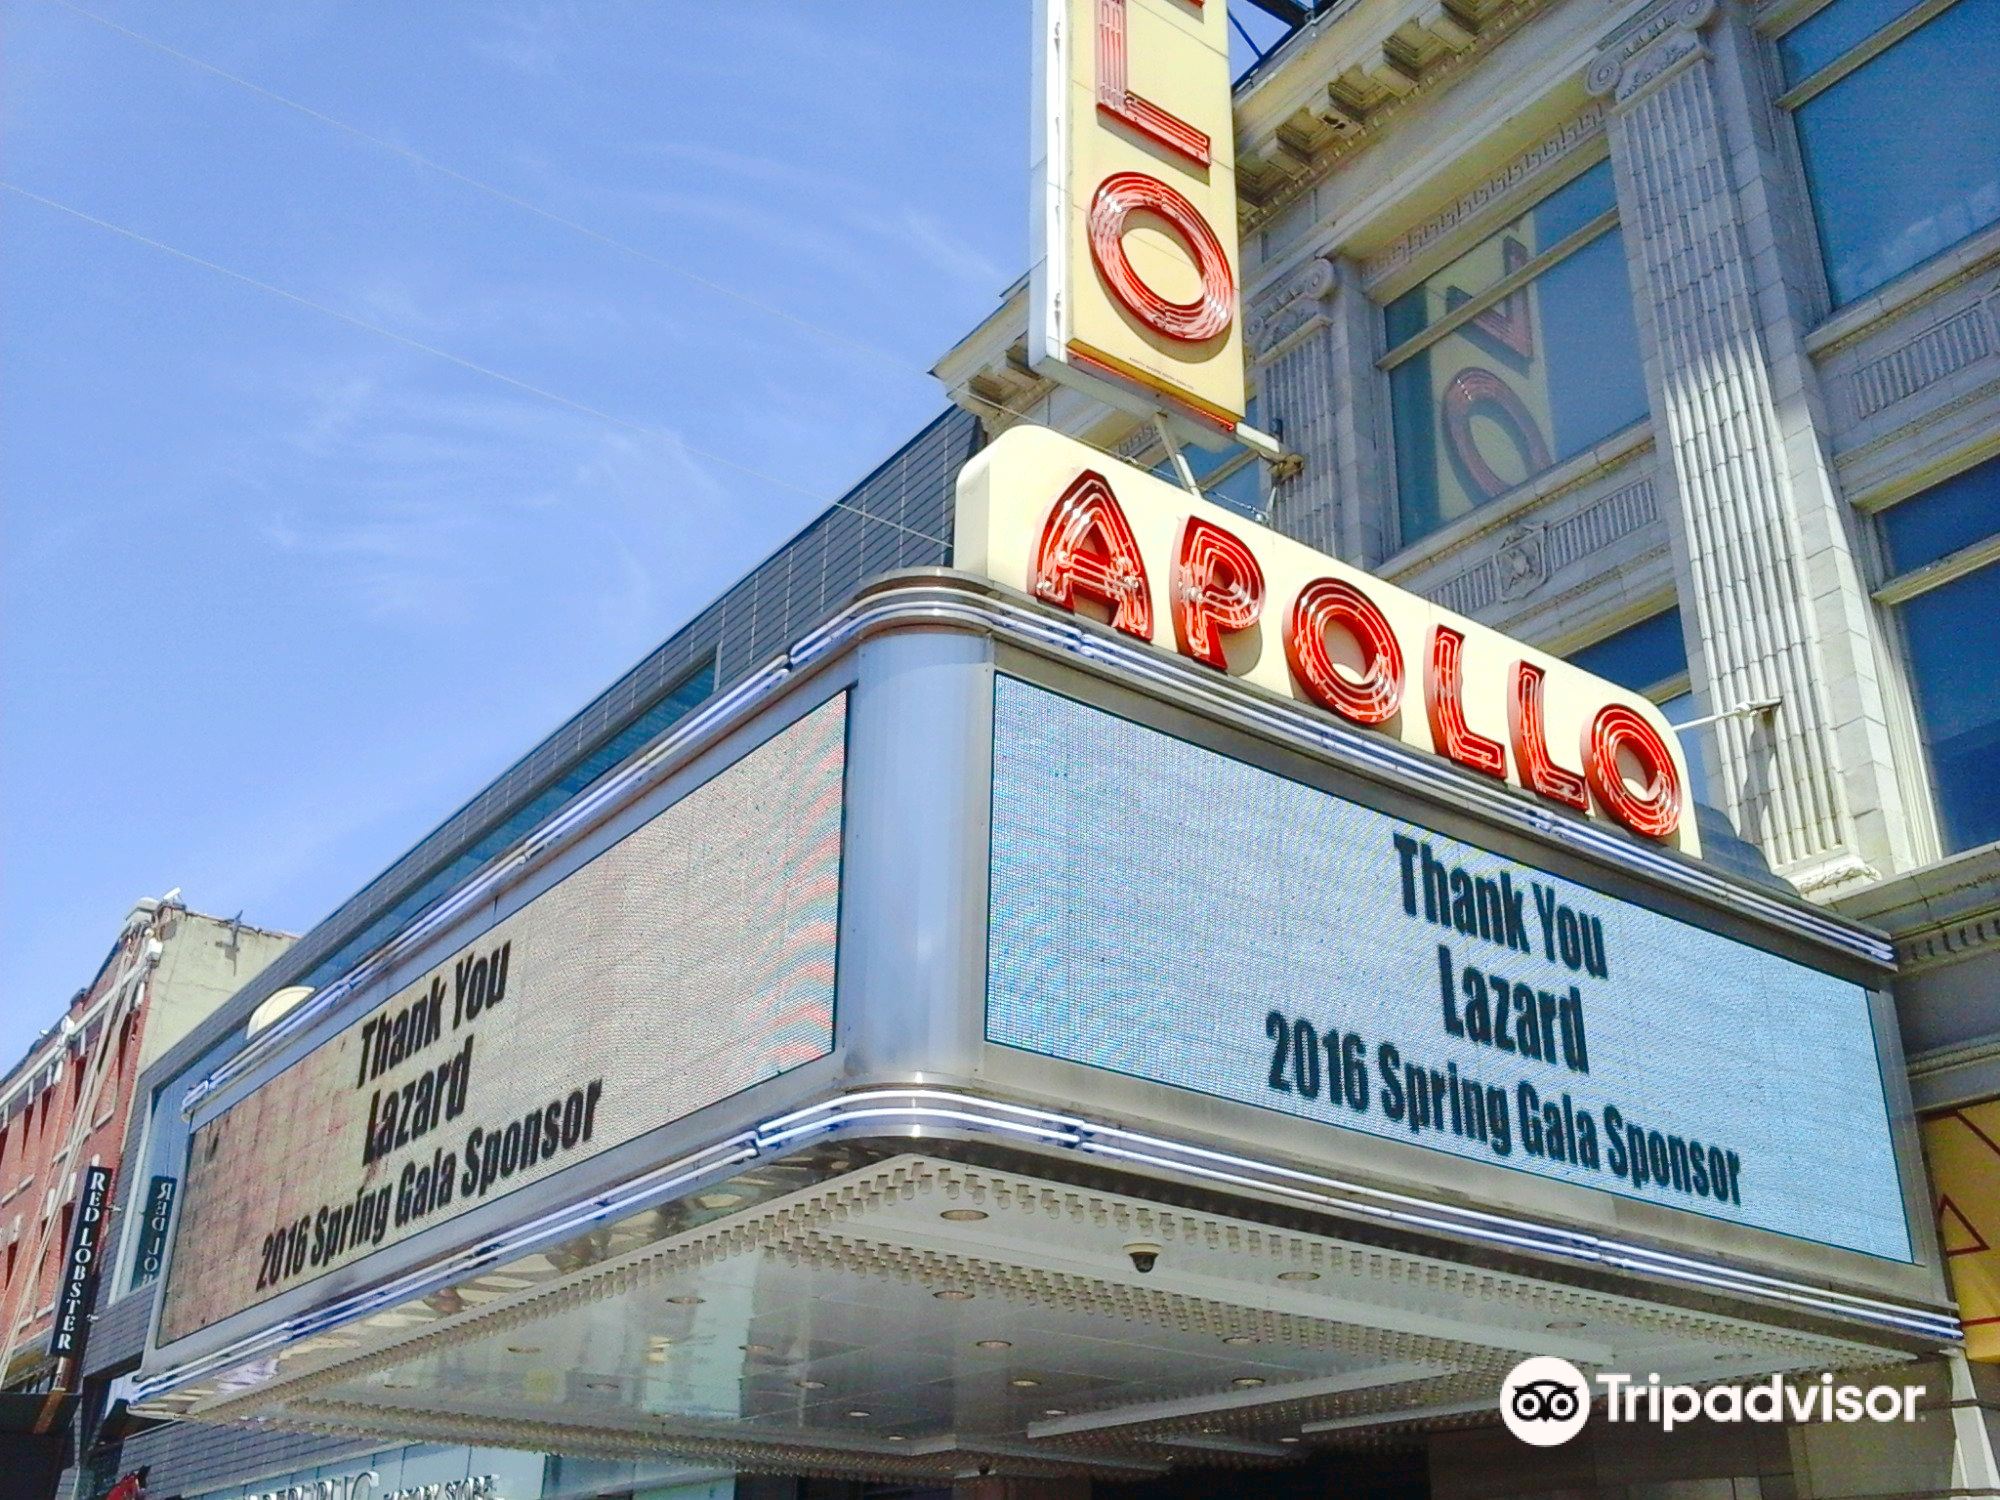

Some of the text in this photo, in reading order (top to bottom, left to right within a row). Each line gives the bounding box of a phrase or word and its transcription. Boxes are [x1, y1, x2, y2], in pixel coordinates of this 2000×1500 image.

[1086, 0, 1234, 342] LO
[1026, 468, 1682, 838] APOLLO
[1393, 833, 1608, 980] Thank You
[356, 940, 512, 1089] Thank You
[1438, 944, 1590, 1074] Lazard
[255, 1078, 602, 1292] 2016 Spring Gala Sponsor
[362, 1034, 474, 1167] Lazard
[1264, 1010, 1742, 1206] 2016 Spring Gala Sponsor
[57, 1171, 105, 1350] RED LOBSTER
